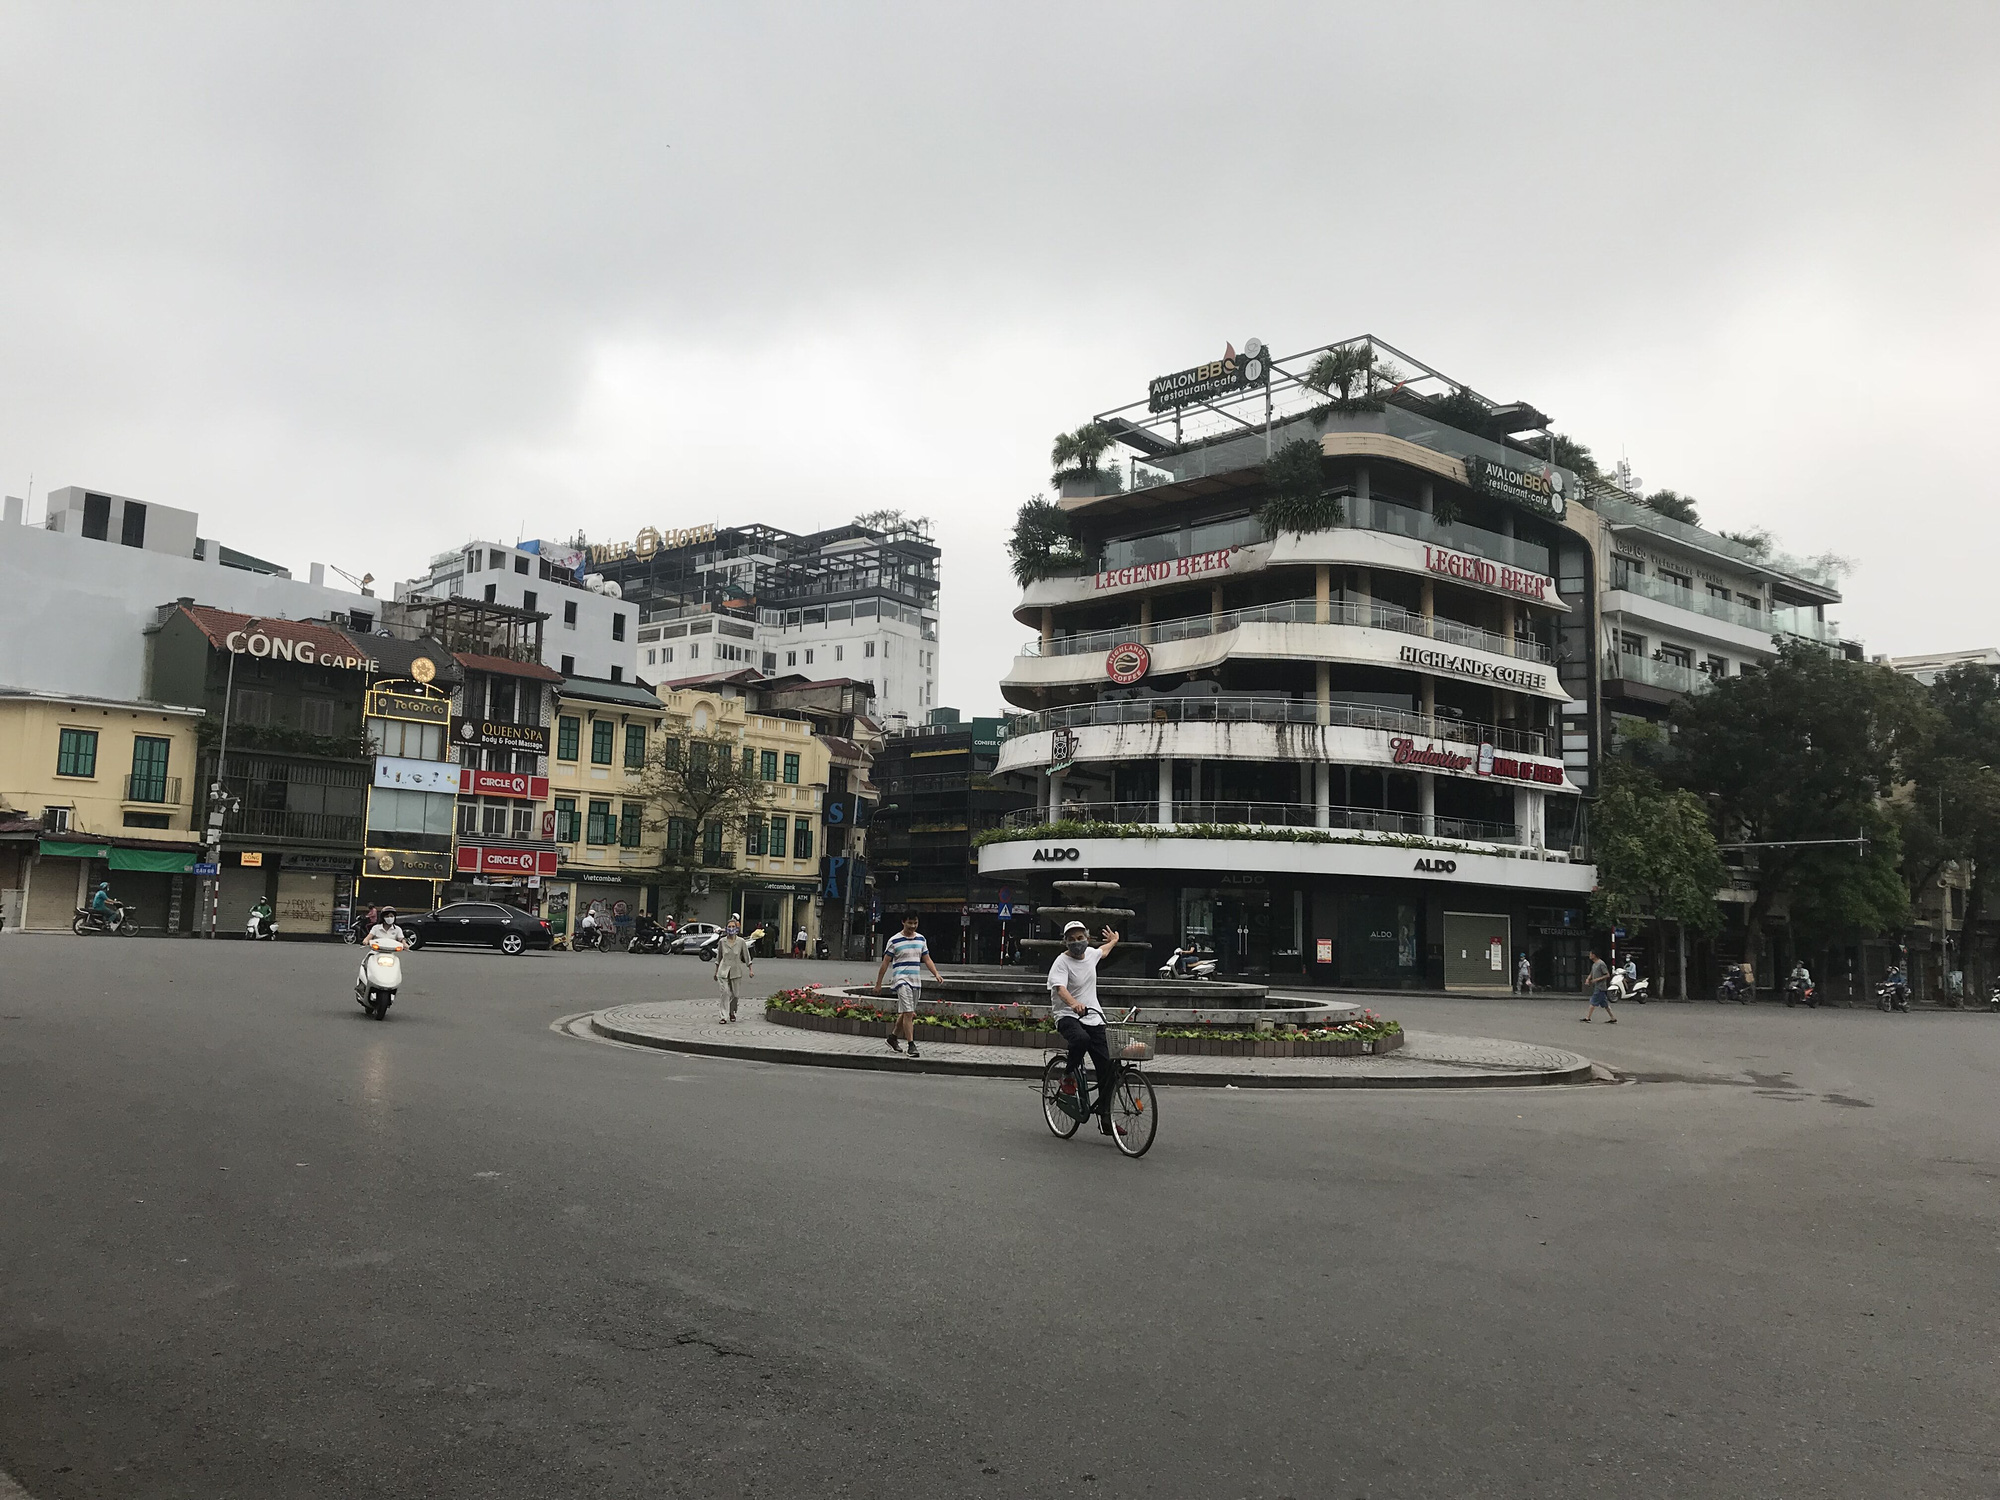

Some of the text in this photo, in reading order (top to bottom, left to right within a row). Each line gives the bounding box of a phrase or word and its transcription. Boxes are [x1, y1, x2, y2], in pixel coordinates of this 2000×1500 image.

[1152, 358, 1239, 394] AVALON BBQ
[1485, 463, 1552, 496] AVALON BBQ
[591, 541, 629, 565] VILLE
[664, 523, 717, 550] HOTEL
[1095, 550, 1230, 590] LEGEND BEER
[1423, 545, 1546, 600] LEGEND BEER
[1108, 645, 1146, 664] HIGHLANDS
[1113, 670, 1142, 682] COFFEE
[1400, 646, 1547, 690] HIGHLANDS COFFEE
[482, 722, 544, 741] QUEEN SPA
[481, 735, 497, 744] Body
[504, 738, 517, 746] Foot
[518, 740, 543, 750] Massage
[1390, 737, 1563, 785] Budweiser KING OF BEERS
[480, 777, 524, 791] CIRCLE K
[544, 813, 554, 832] K
[487, 855, 532, 868] CIRCLE K
[1032, 848, 1080, 862] ALDO
[1413, 858, 1457, 873] ALDO
[583, 874, 622, 883] Vietcombank
[1220, 875, 1265, 884] ALDO
